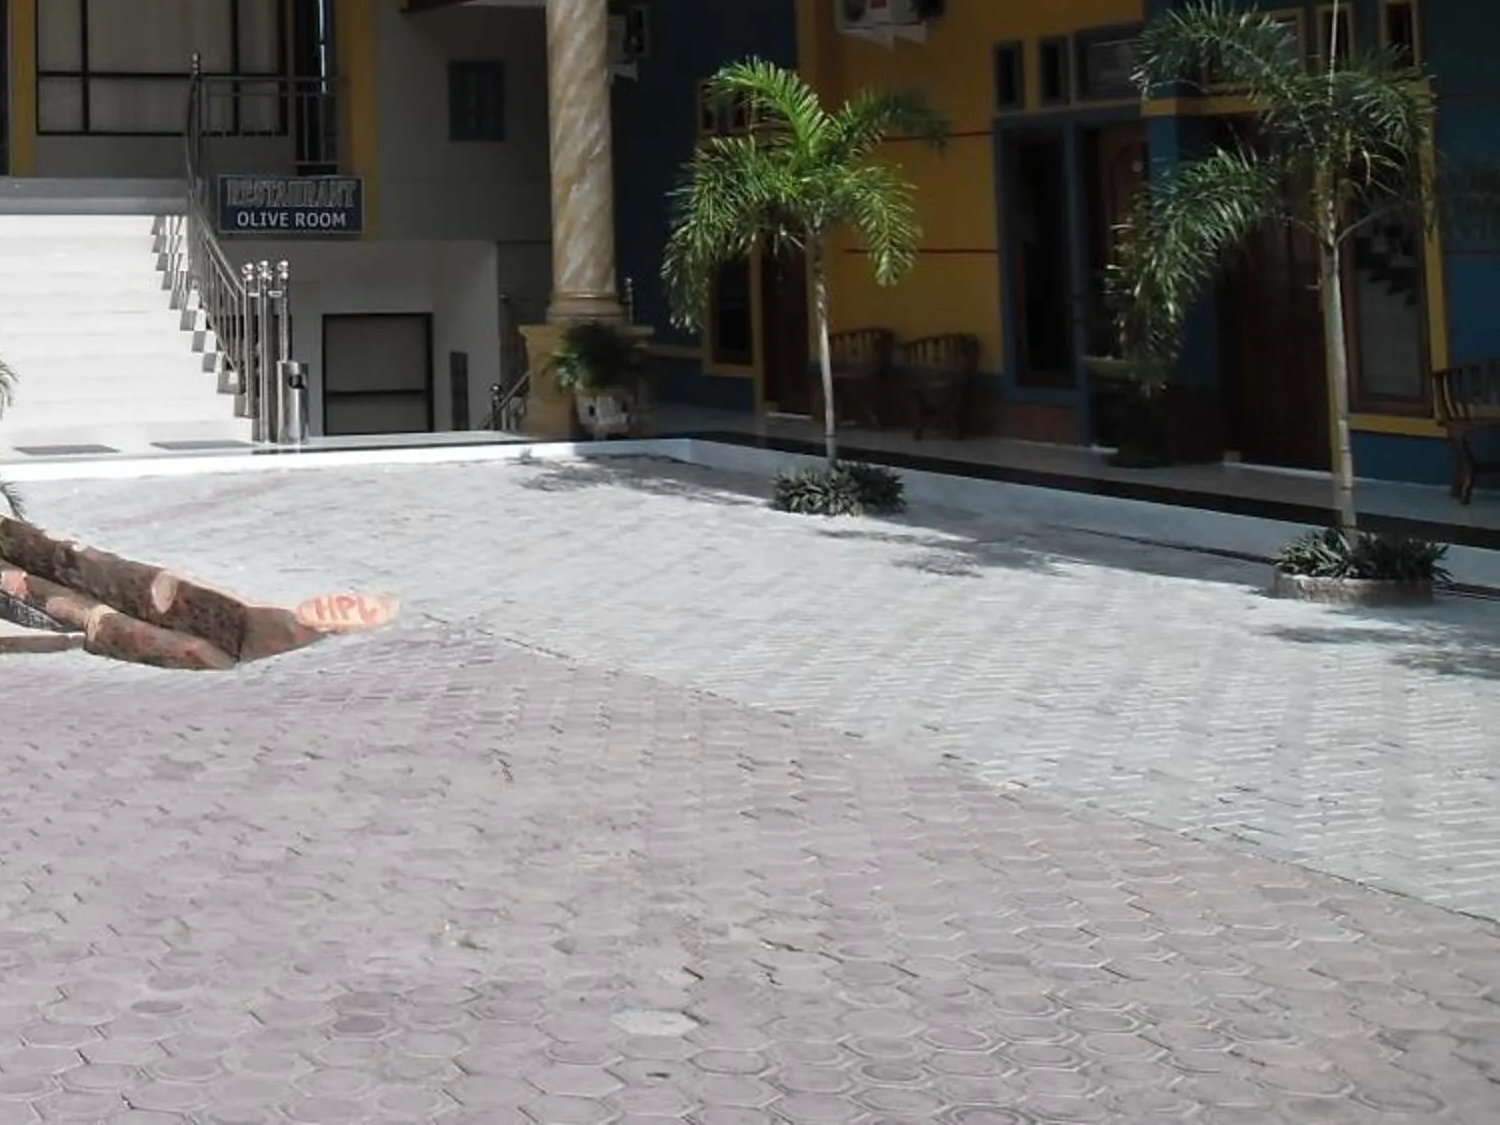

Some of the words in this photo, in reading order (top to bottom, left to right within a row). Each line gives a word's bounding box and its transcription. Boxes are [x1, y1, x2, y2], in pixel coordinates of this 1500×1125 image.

[226, 179, 357, 208] RESTAURANT
[237, 211, 289, 227] OLIVE
[295, 212, 346, 228] ROOM
